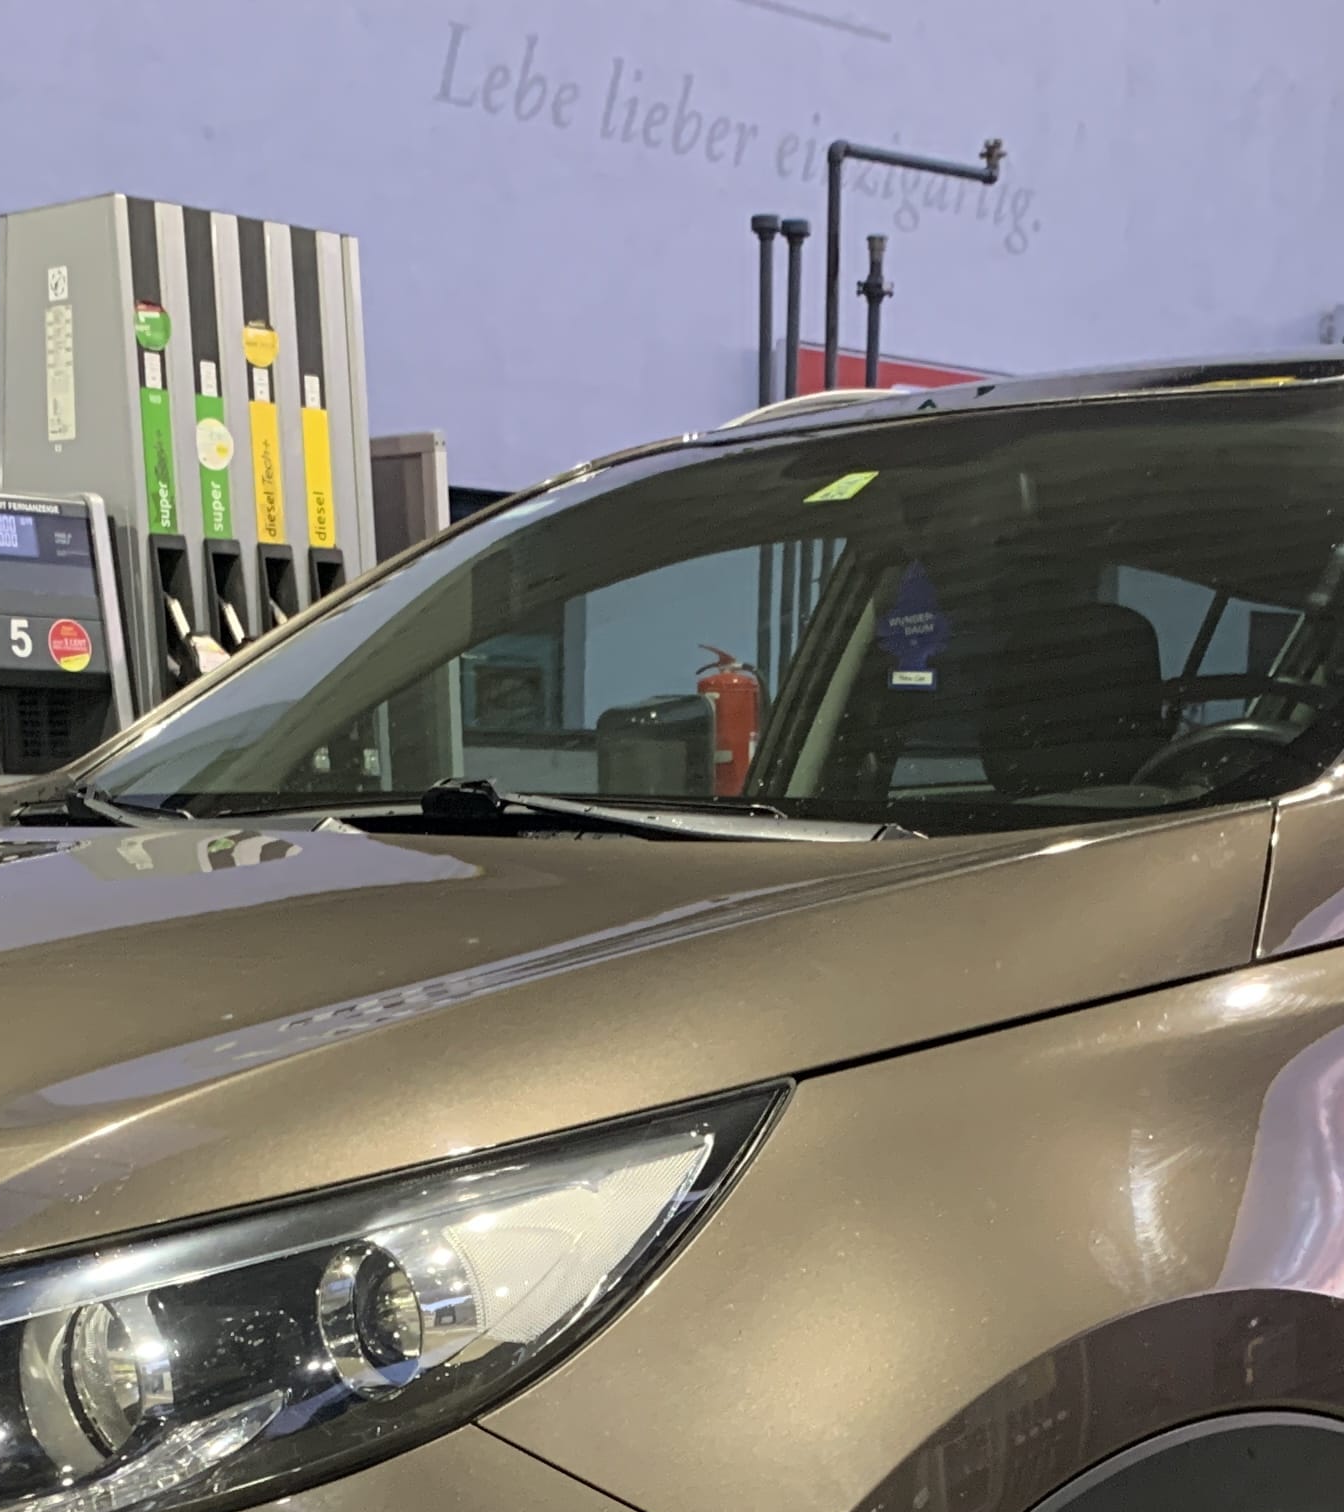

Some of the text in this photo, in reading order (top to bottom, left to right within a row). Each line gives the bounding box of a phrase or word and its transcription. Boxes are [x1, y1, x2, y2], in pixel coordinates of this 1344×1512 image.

[434, 20, 580, 130] Lebe
[599, 56, 758, 168] lieber
[158, 481, 172, 528] super
[210, 481, 225, 532] super
[263, 491, 277, 537] diesel
[312, 491, 327, 541] diesel
[10, 618, 33, 659] 5
[905, 623, 935, 636] BAUM
